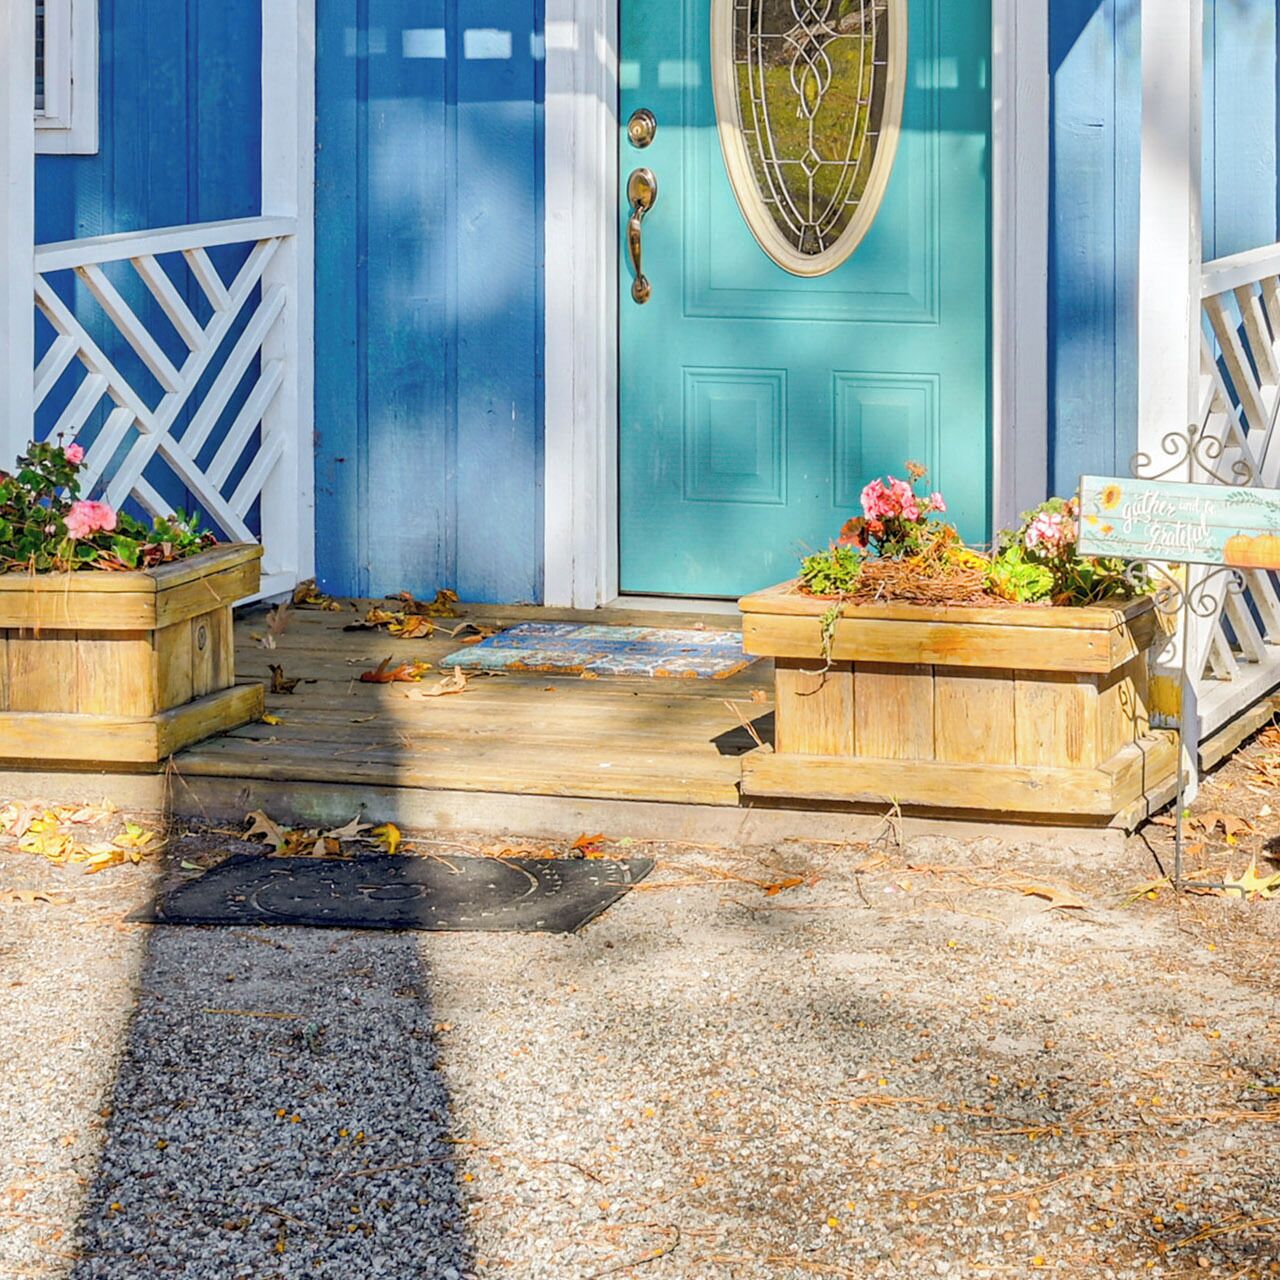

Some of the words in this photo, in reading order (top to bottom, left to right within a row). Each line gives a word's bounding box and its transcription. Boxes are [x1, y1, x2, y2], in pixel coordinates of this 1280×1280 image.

[1122, 490, 1177, 533] gather
[1179, 496, 1201, 512] and
[1145, 512, 1212, 554] grateful
